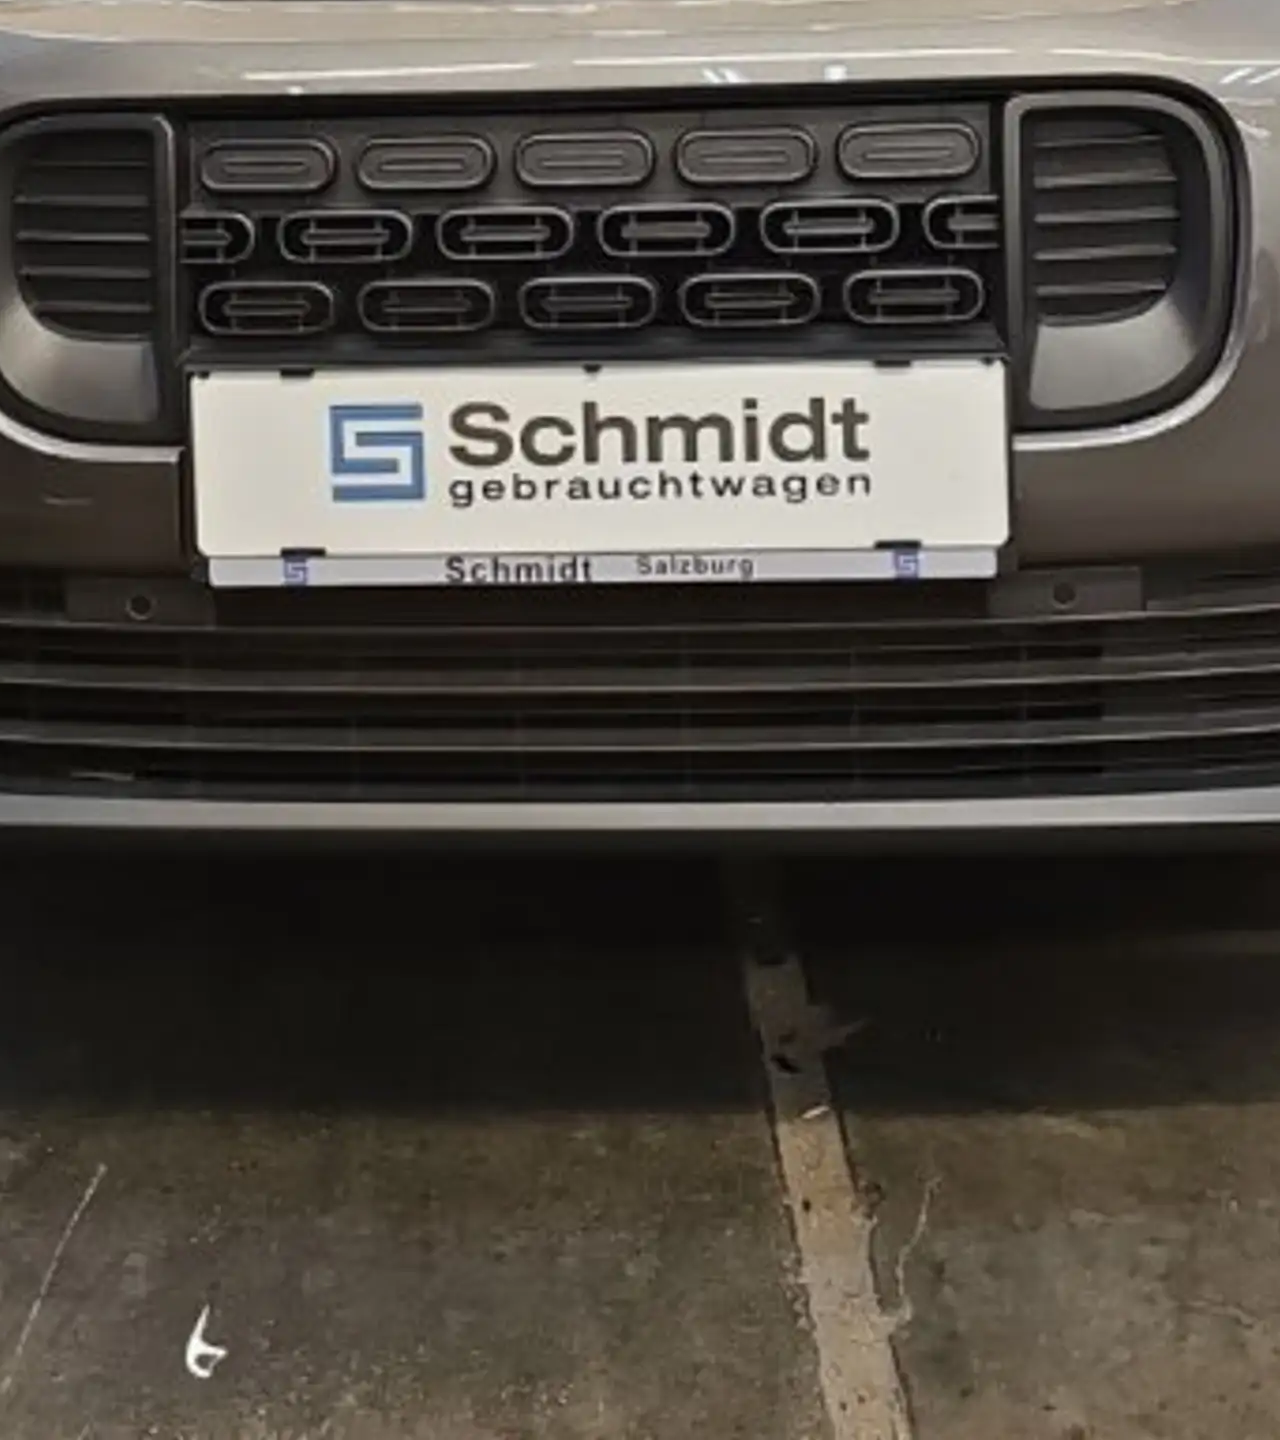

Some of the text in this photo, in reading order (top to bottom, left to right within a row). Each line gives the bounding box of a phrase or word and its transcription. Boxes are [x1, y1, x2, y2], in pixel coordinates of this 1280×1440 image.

[448, 397, 870, 467] Schmidt
[448, 470, 871, 508] gebrauchtwagen
[445, 553, 755, 584] Schmidt Salzburg
